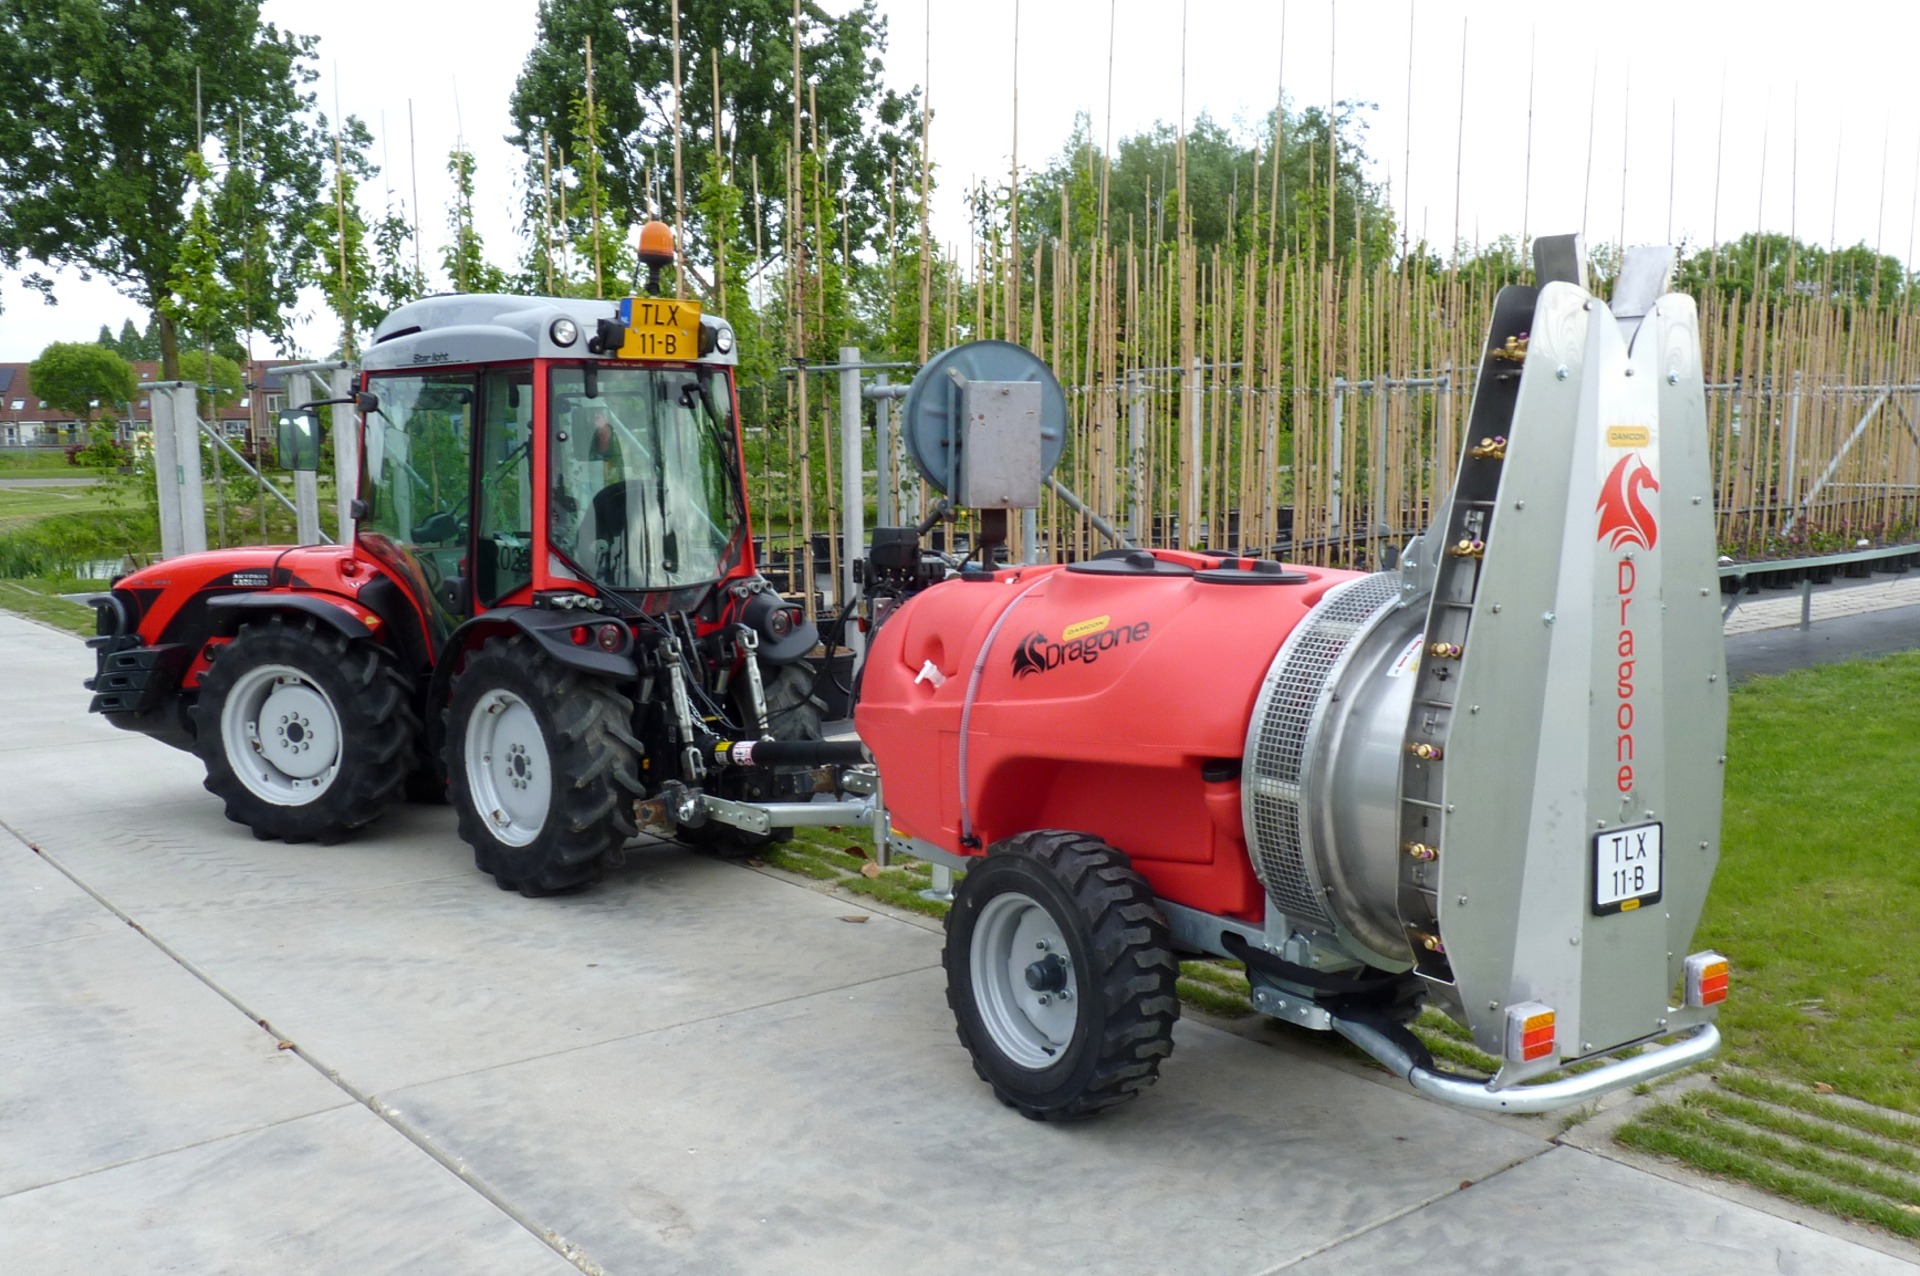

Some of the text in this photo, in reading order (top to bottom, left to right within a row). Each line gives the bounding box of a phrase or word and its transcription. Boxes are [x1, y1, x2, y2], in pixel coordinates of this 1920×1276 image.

[641, 303, 680, 326] TLX
[640, 333, 677, 355] 11-B
[1611, 432, 1647, 441] DAMCON
[1045, 621, 1151, 671] Dragone
[1617, 560, 1637, 793] Dragone
[1612, 832, 1647, 863] TLX
[1613, 865, 1645, 896] 11-B
